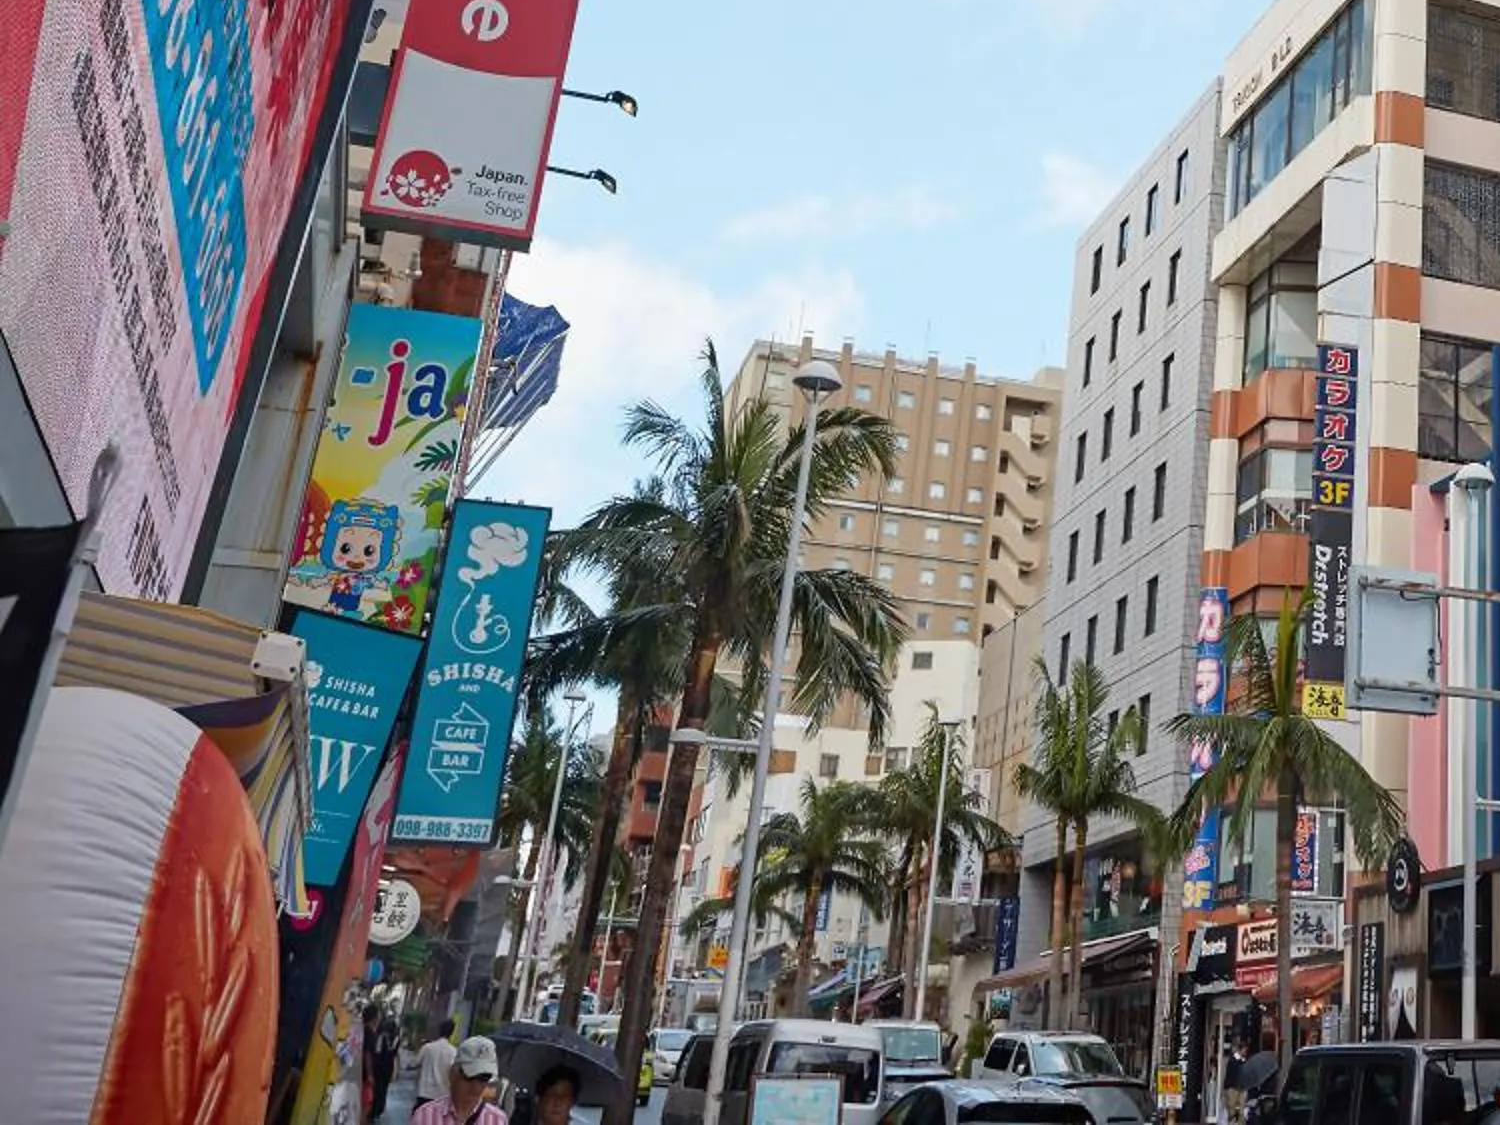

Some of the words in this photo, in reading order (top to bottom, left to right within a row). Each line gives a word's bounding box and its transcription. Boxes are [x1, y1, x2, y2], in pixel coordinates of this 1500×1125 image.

[475, 164, 528, 186] Japan.
[466, 180, 525, 204] Tax-free
[484, 200, 523, 222] Shop
[1320, 347, 1353, 472] カラオケ
[1318, 480, 1350, 505] 3F
[325, 676, 376, 698] SHISHA
[427, 661, 514, 693] SHISHA
[308, 693, 380, 720] CAFE&BAR
[444, 725, 478, 741] CAFE
[442, 753, 471, 768] BAR
